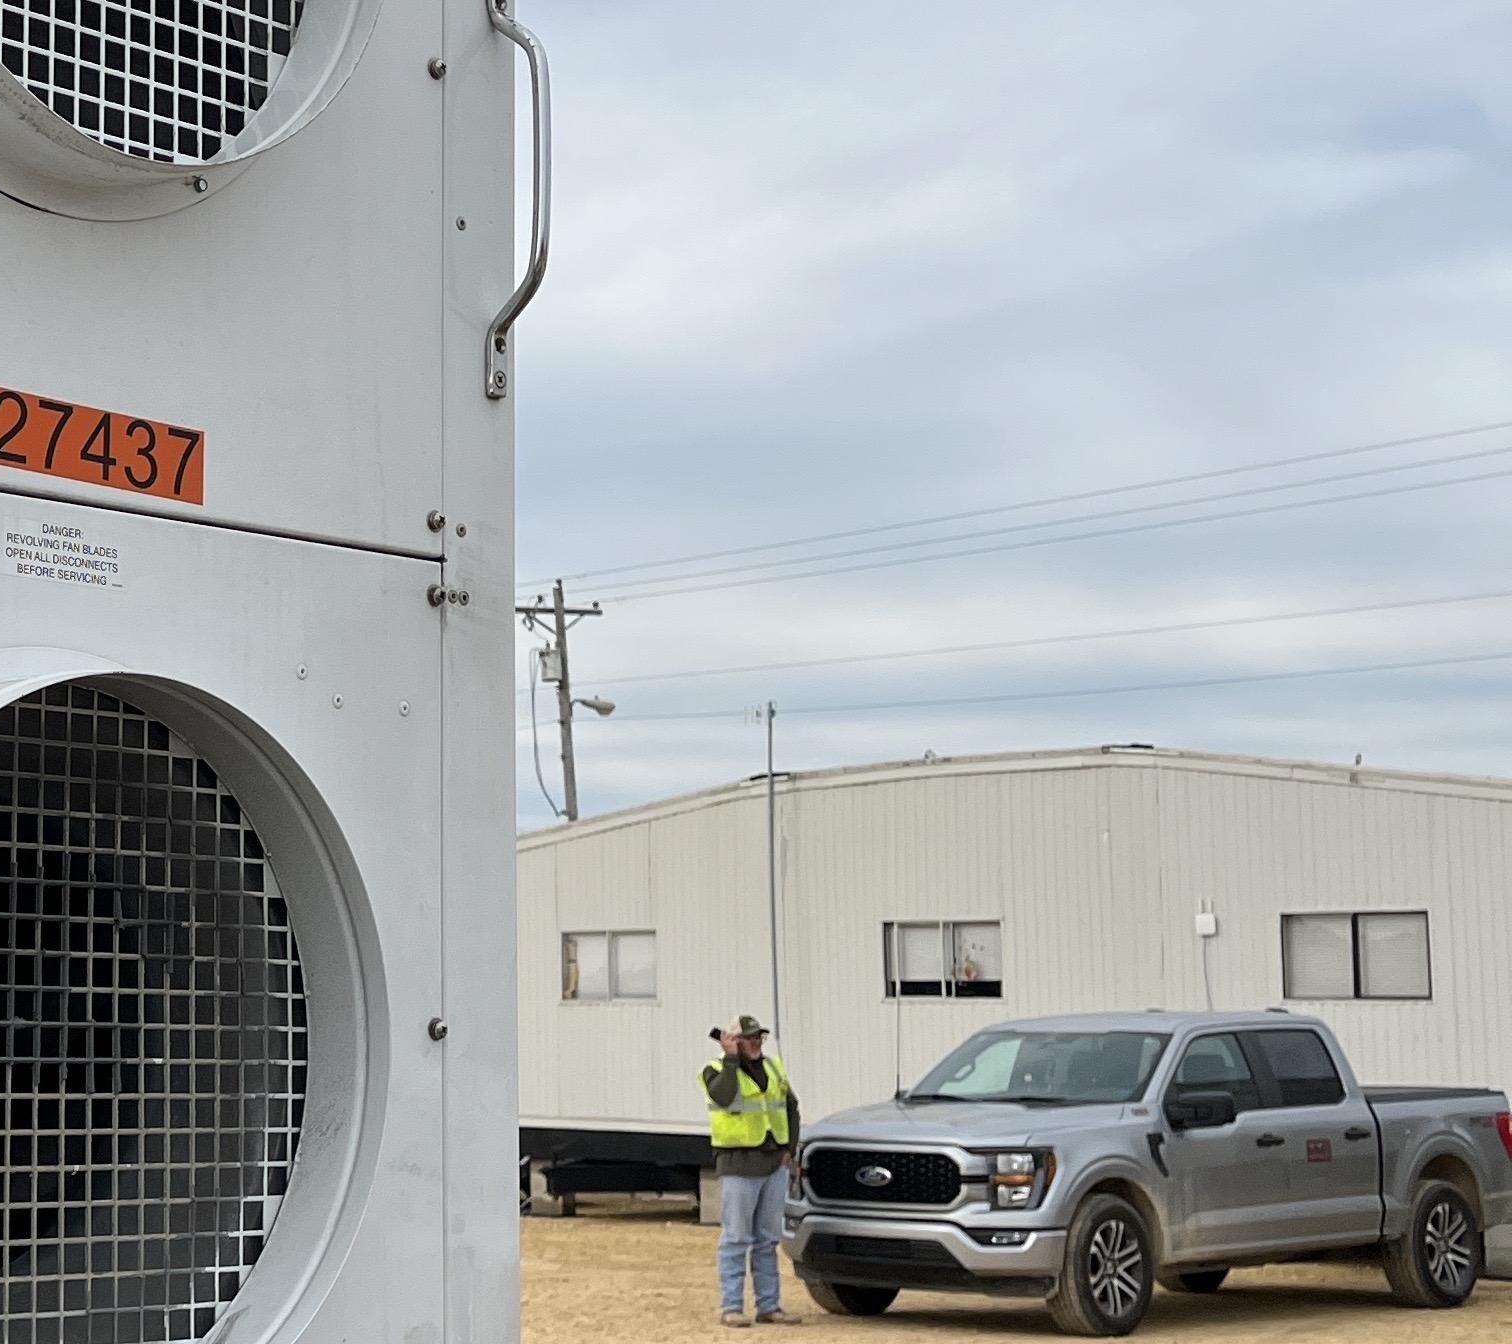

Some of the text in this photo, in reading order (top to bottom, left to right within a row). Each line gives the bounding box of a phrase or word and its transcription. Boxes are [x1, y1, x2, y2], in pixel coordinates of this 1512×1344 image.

[6, 532, 118, 559] REVOLVING FAN BLADES
[5, 547, 119, 574] OPEN ALL DISCONNECTS
[16, 562, 108, 586] BEFORE SERVICING
